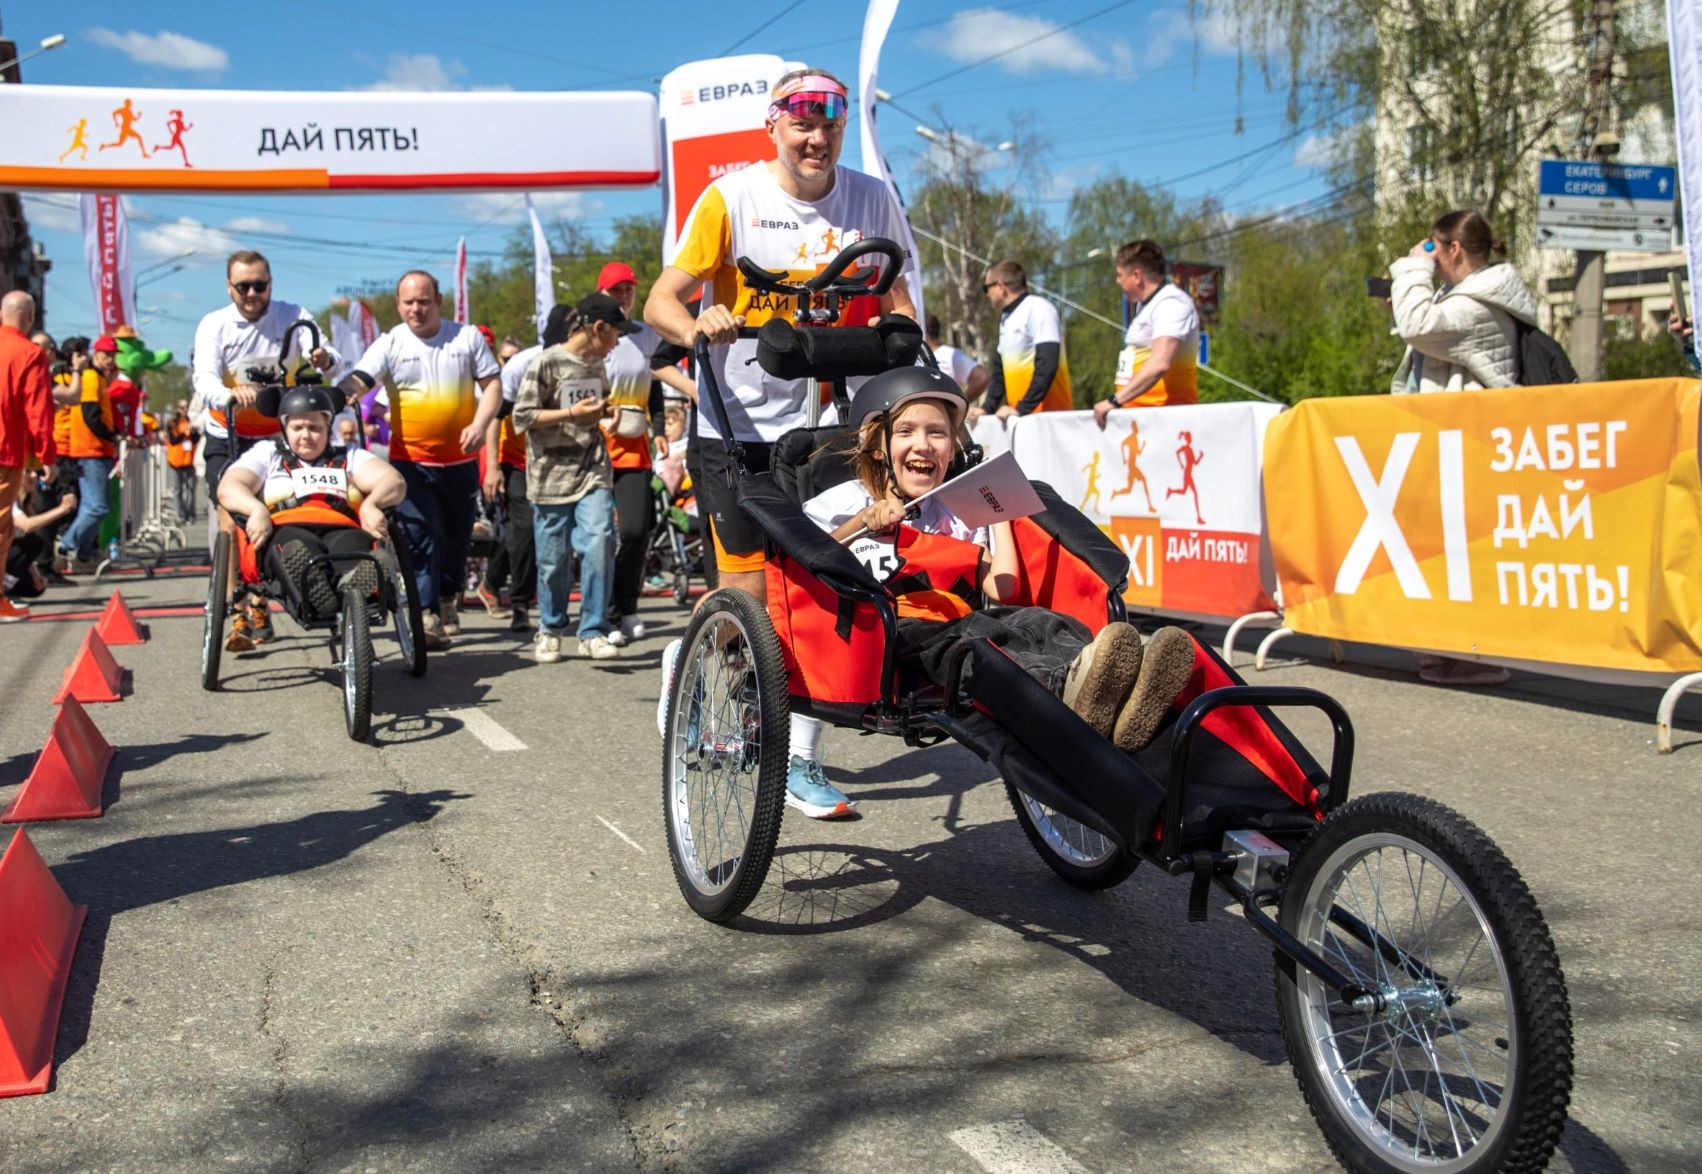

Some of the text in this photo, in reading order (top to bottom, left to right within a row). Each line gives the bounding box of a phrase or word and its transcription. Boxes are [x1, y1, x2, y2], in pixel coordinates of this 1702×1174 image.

[699, 80, 768, 102] ЕВРАЗ
[258, 123, 419, 156] ДАЙ ПЯТЬ!
[1564, 181, 1607, 195] СЕРОВ
[761, 220, 799, 230] ЕВРАЗ
[1490, 420, 1627, 472] ЗАБЕГ
[302, 474, 338, 485] 1548
[1333, 429, 1473, 602] XI
[1493, 479, 1594, 548] ДАЙ
[855, 543, 880, 554] ЕВРАЗ
[1119, 534, 1154, 586] XI
[1166, 532, 1248, 564] ДАЙ ПЯТЬ!
[1496, 561, 1629, 612] ПЯТЬ!
